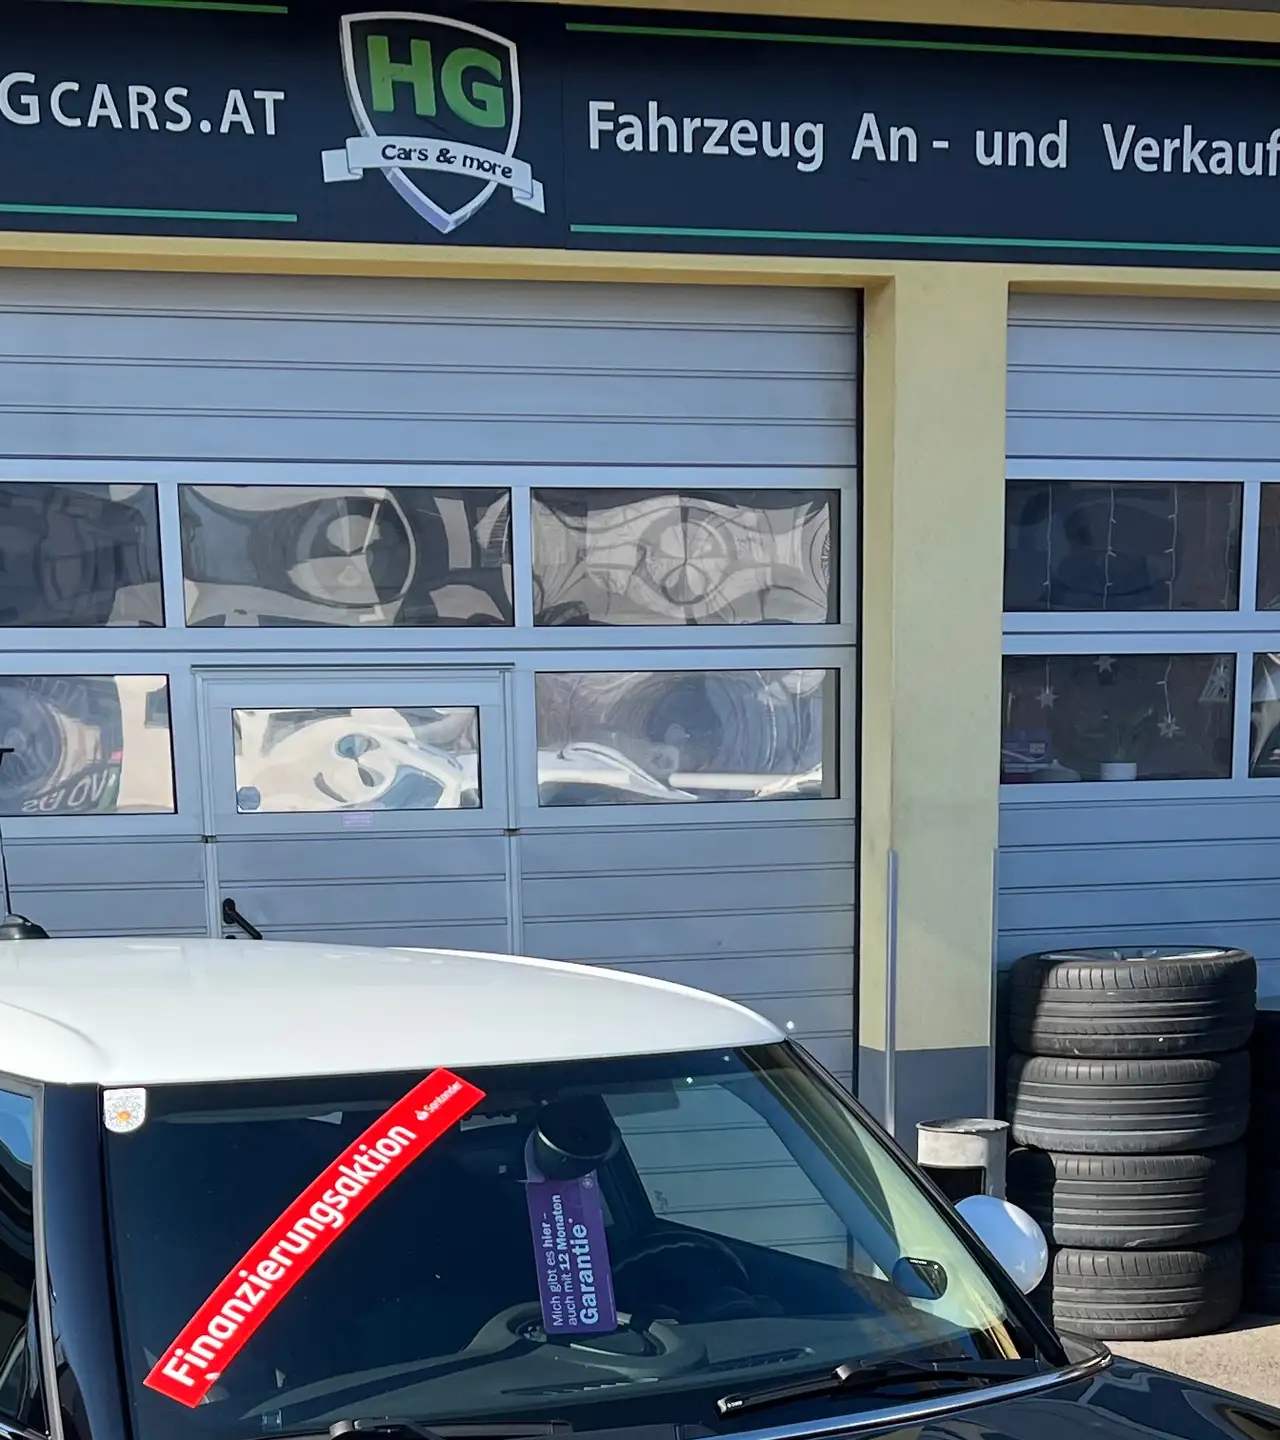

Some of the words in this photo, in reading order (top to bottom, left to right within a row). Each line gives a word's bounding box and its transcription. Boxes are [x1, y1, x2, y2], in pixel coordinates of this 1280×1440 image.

[366, 35, 506, 128] HG
[586, 100, 824, 171] Fahrzeug
[974, 120, 1068, 170] und
[381, 144, 429, 161] Cars
[435, 148, 457, 165] &
[462, 154, 514, 179] more
[423, 1080, 463, 1115] Santander
[541, 1221, 554, 1248] hier
[161, 1124, 417, 1387] Finanzierungsaktion
[546, 1251, 556, 1266] es
[558, 1252, 570, 1270] 12
[547, 1269, 562, 1293] gibt
[561, 1272, 574, 1293] mit
[550, 1295, 564, 1326] Mich
[563, 1295, 578, 1326] auch
